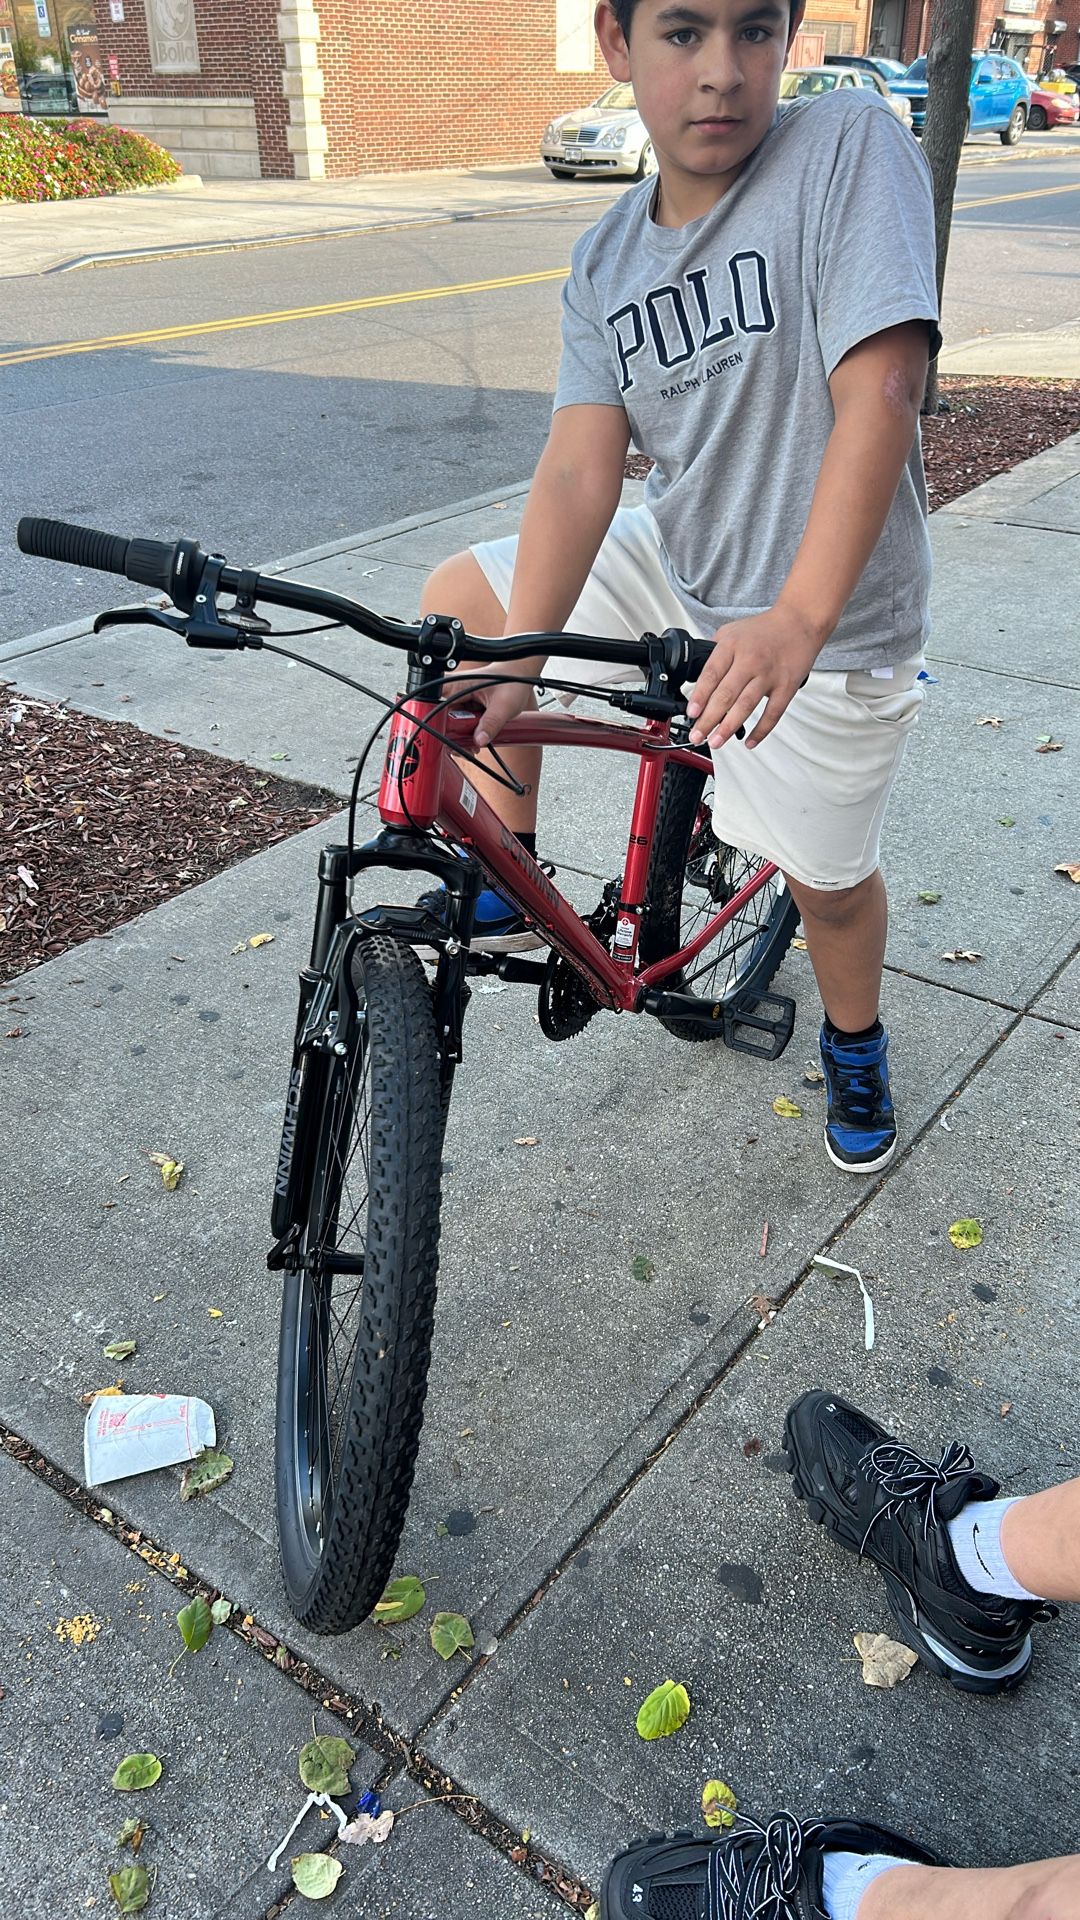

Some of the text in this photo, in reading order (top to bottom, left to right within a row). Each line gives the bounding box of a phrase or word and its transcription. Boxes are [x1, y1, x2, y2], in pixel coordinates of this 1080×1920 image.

[157, 42, 195, 63] Bolla
[606, 249, 777, 393] POLO
[660, 352, 744, 400] RALPH LAUREN
[630, 833, 648, 845] 26
[275, 1067, 301, 1197] SCHWINN
